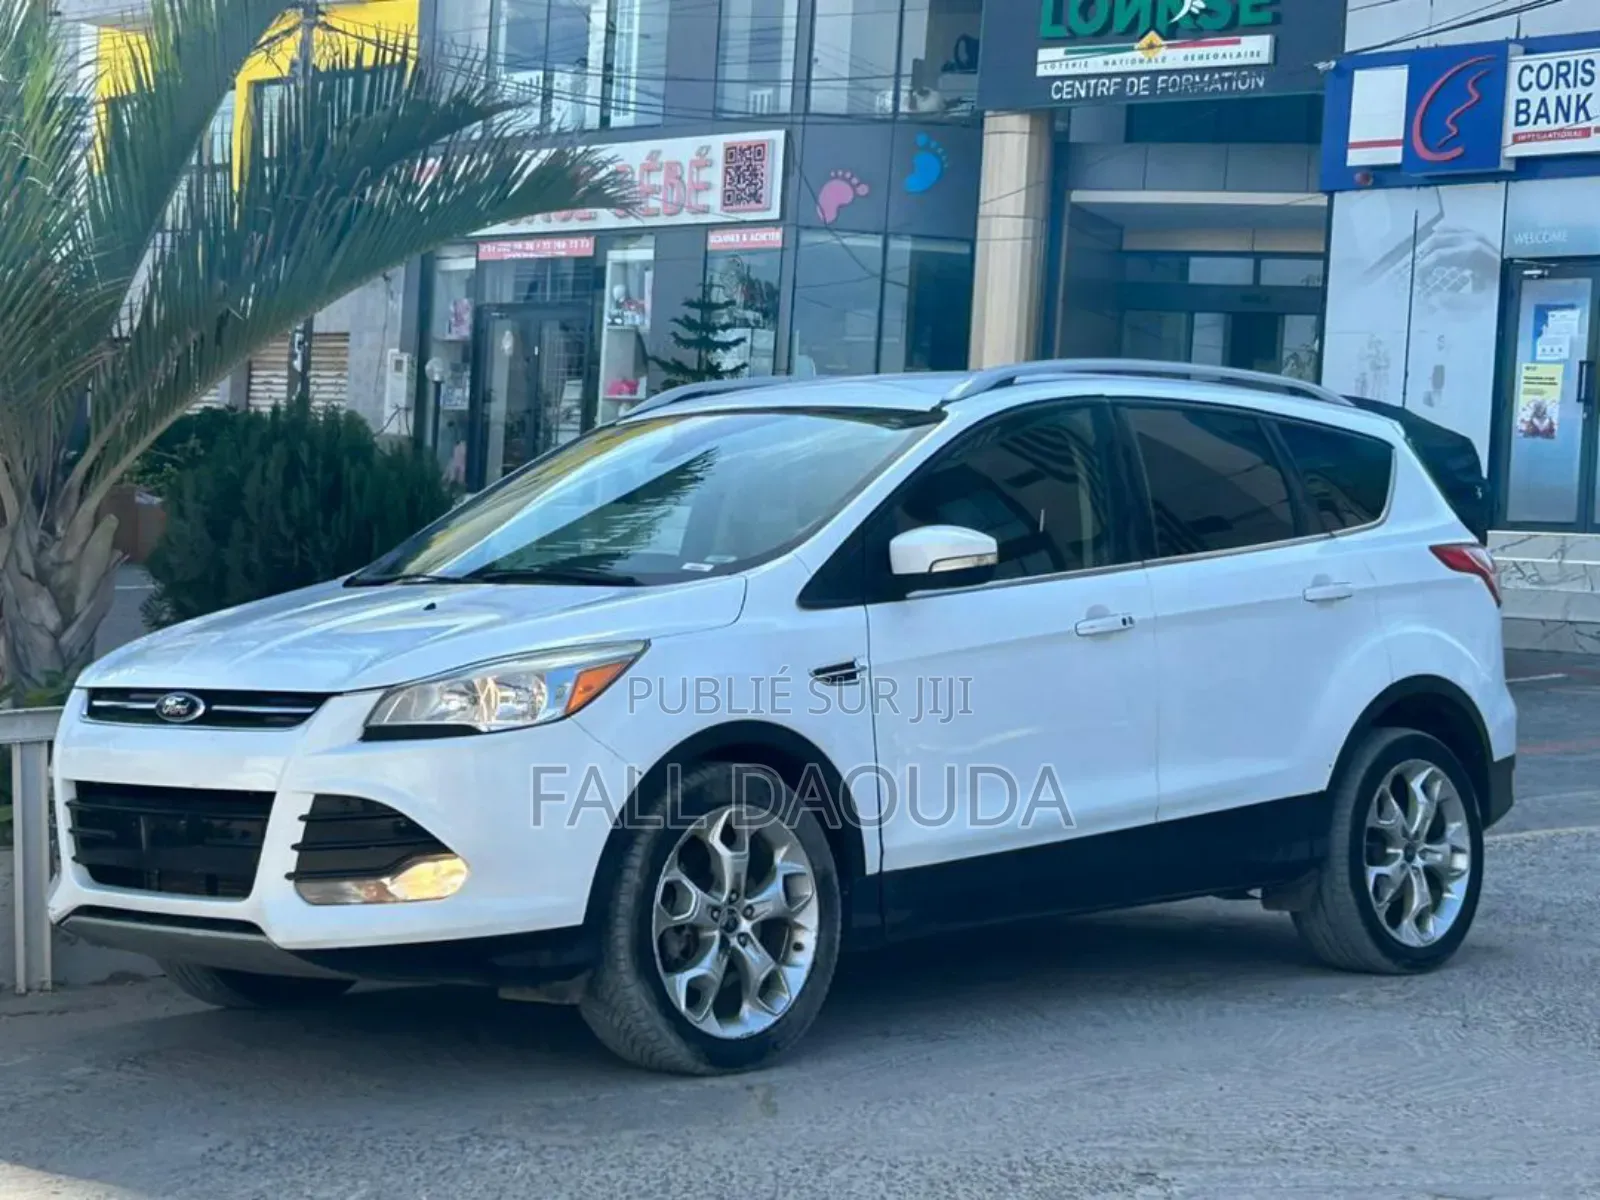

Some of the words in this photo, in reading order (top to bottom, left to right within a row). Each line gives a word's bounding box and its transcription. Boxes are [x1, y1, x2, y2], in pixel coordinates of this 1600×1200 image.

[1126, 76, 1150, 96] DE
[1156, 71, 1266, 95] FORMATION
[1517, 58, 1595, 92] CORIS
[1514, 92, 1593, 127] BANK
[1513, 231, 1568, 245] WELCOME
